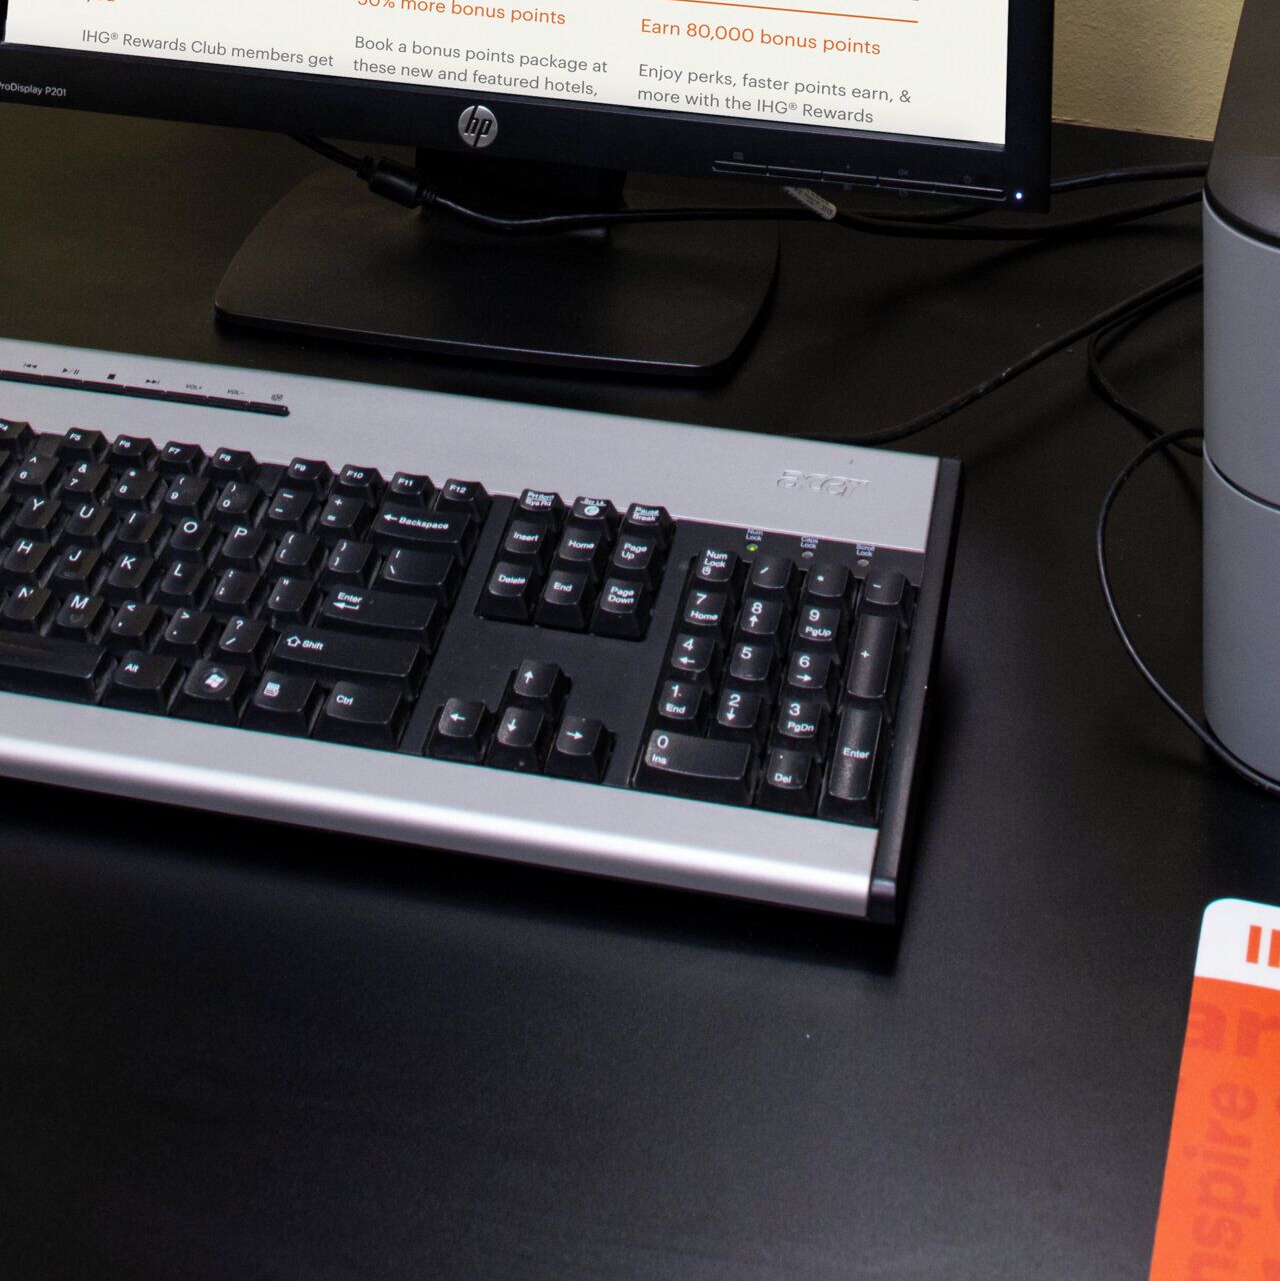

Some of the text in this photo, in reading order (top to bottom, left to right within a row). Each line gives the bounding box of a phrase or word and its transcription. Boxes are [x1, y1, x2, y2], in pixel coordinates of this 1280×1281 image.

[452, 0, 505, 19] bonus
[511, 7, 566, 25] points
[123, 33, 187, 52] Rewards
[191, 40, 227, 56] Club
[231, 45, 304, 64] members
[308, 54, 334, 67] get
[354, 35, 608, 73] Book a bonus points package at
[641, 19, 881, 55] Earn 80,000 bonus points
[45, 87, 66, 97] P201
[354, 59, 598, 97] these new and featured hotels,
[639, 63, 911, 104] Enjoy perks, faster points earn, &
[638, 88, 680, 104] more
[685, 91, 720, 108] with
[725, 96, 752, 111] the
[803, 103, 874, 123] Rewards
[462, 105, 494, 148] hp
[398, 516, 449, 531] Backspace
[337, 592, 362, 605] Enter
[498, 574, 572, 593] Delete End
[690, 609, 718, 622] Home
